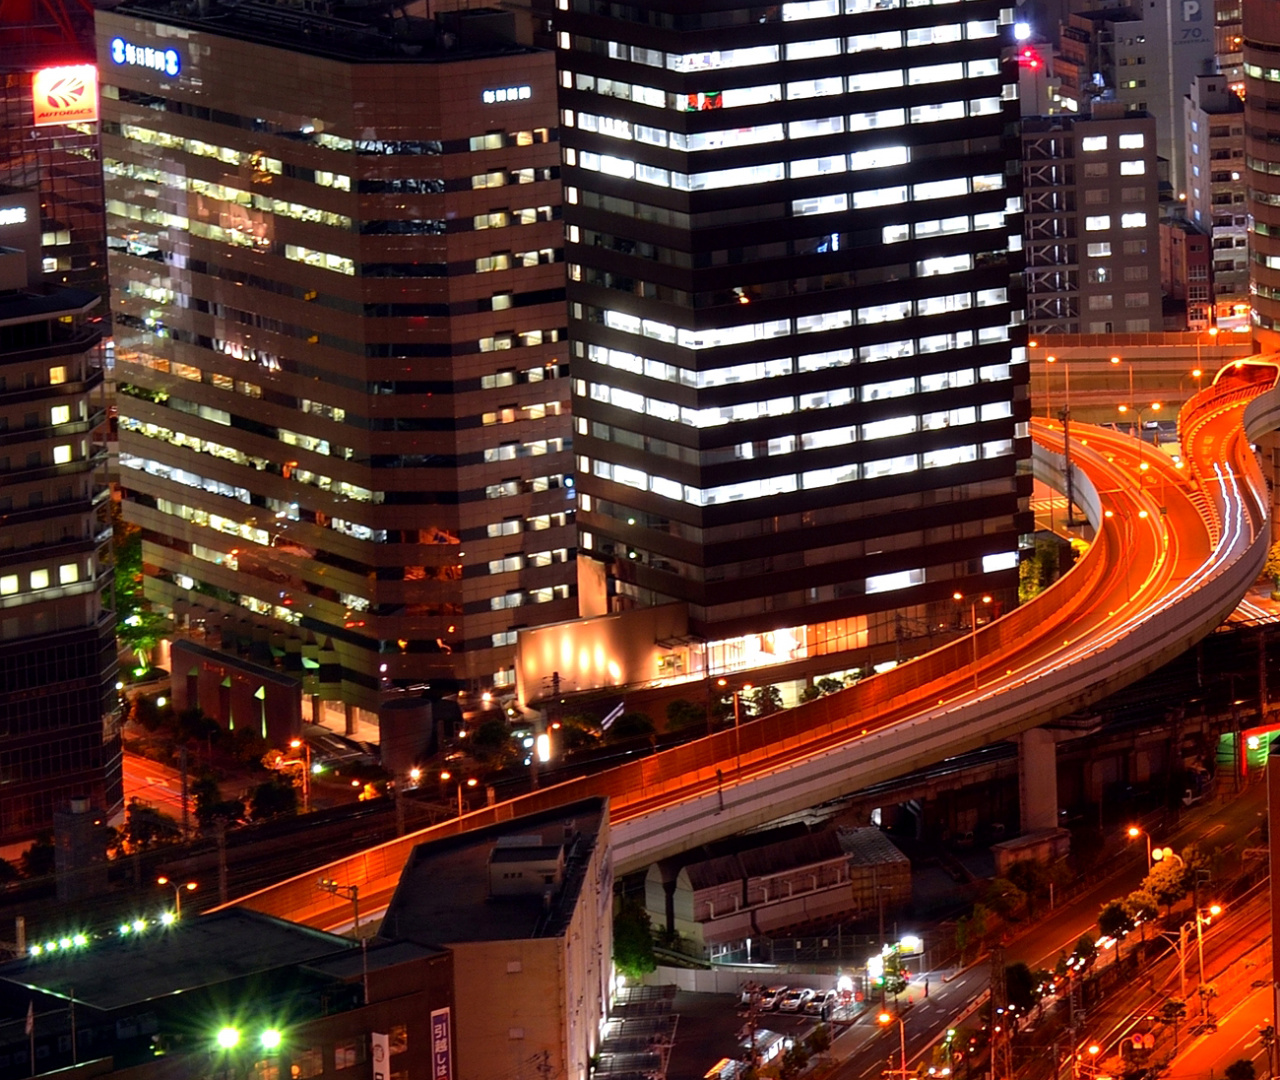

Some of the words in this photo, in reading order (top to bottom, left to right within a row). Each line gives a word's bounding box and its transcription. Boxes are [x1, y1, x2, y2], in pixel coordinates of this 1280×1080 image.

[1183, 0, 1200, 22] P
[38, 107, 93, 119] AUTOBACS
[434, 1022, 448, 1080] 引越しは
